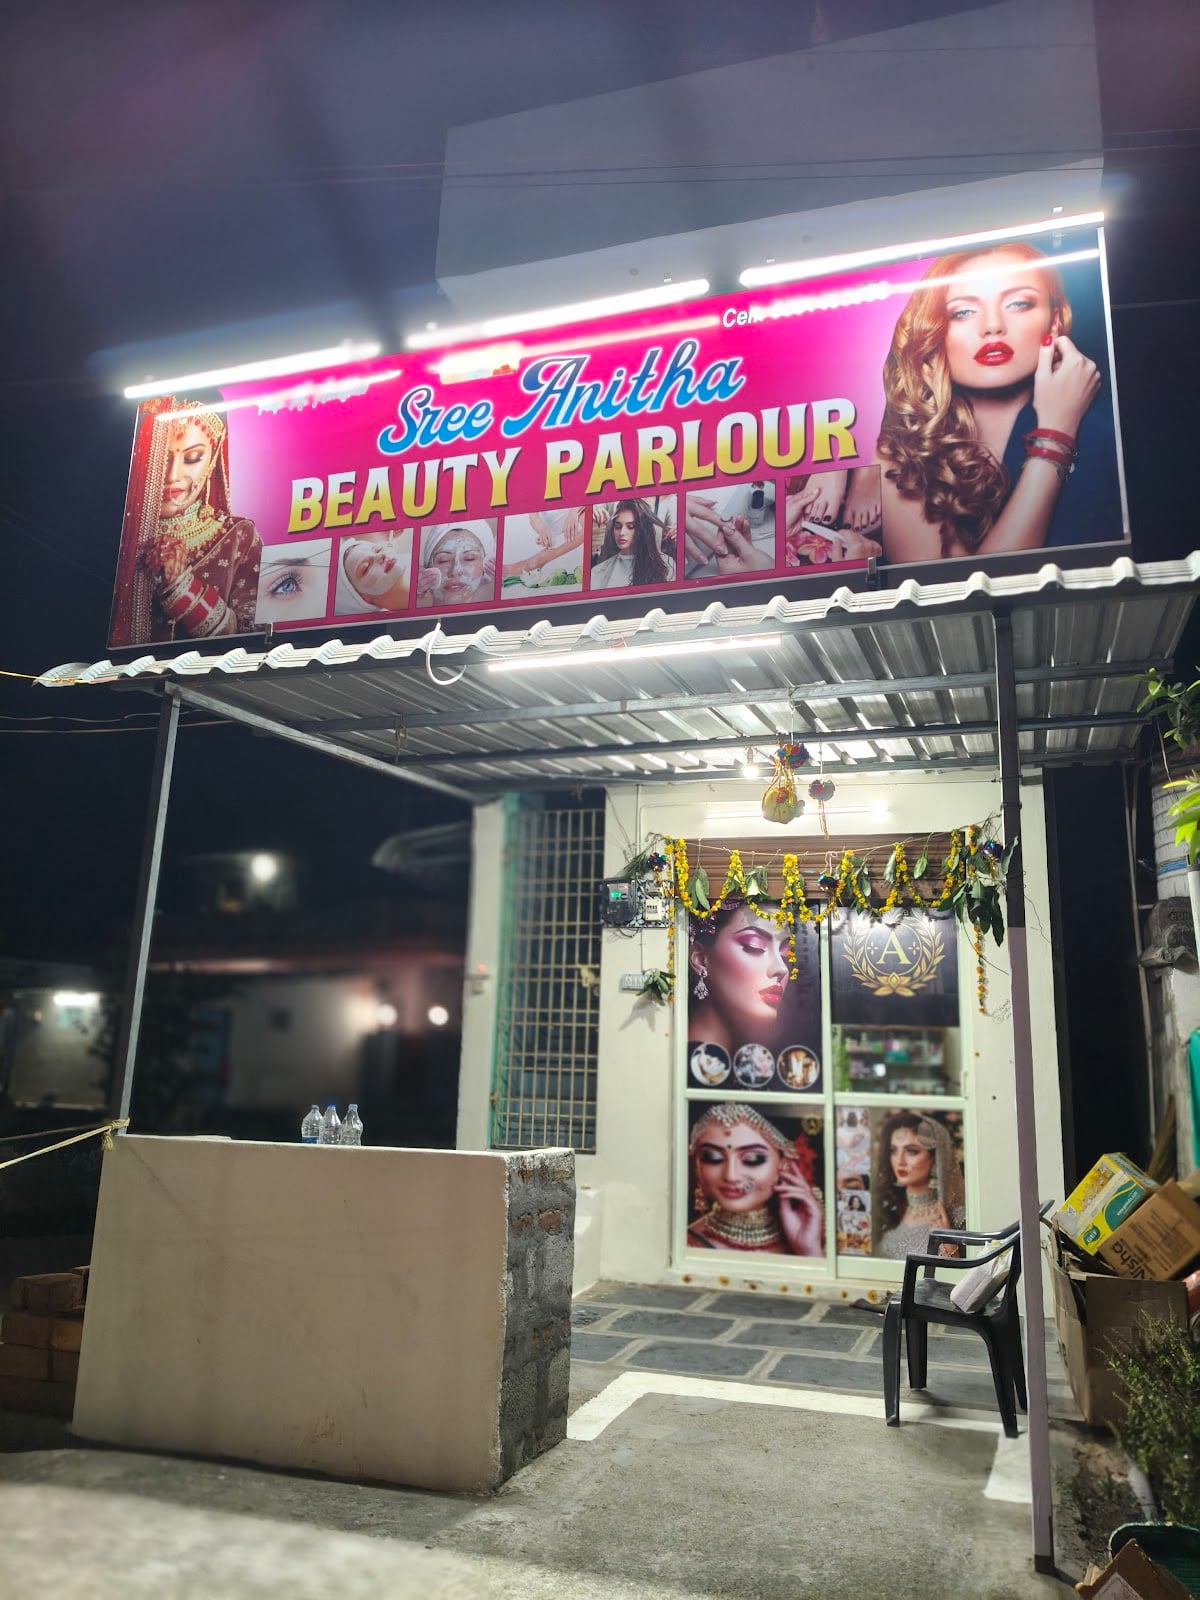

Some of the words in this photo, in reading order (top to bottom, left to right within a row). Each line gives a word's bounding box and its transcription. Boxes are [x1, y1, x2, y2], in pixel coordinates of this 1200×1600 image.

[377, 385, 496, 456] Sree
[501, 339, 746, 438] Anitha
[287, 447, 522, 533] BEAUTY
[543, 398, 859, 500] PARLOUR
[876, 929, 912, 965] A
